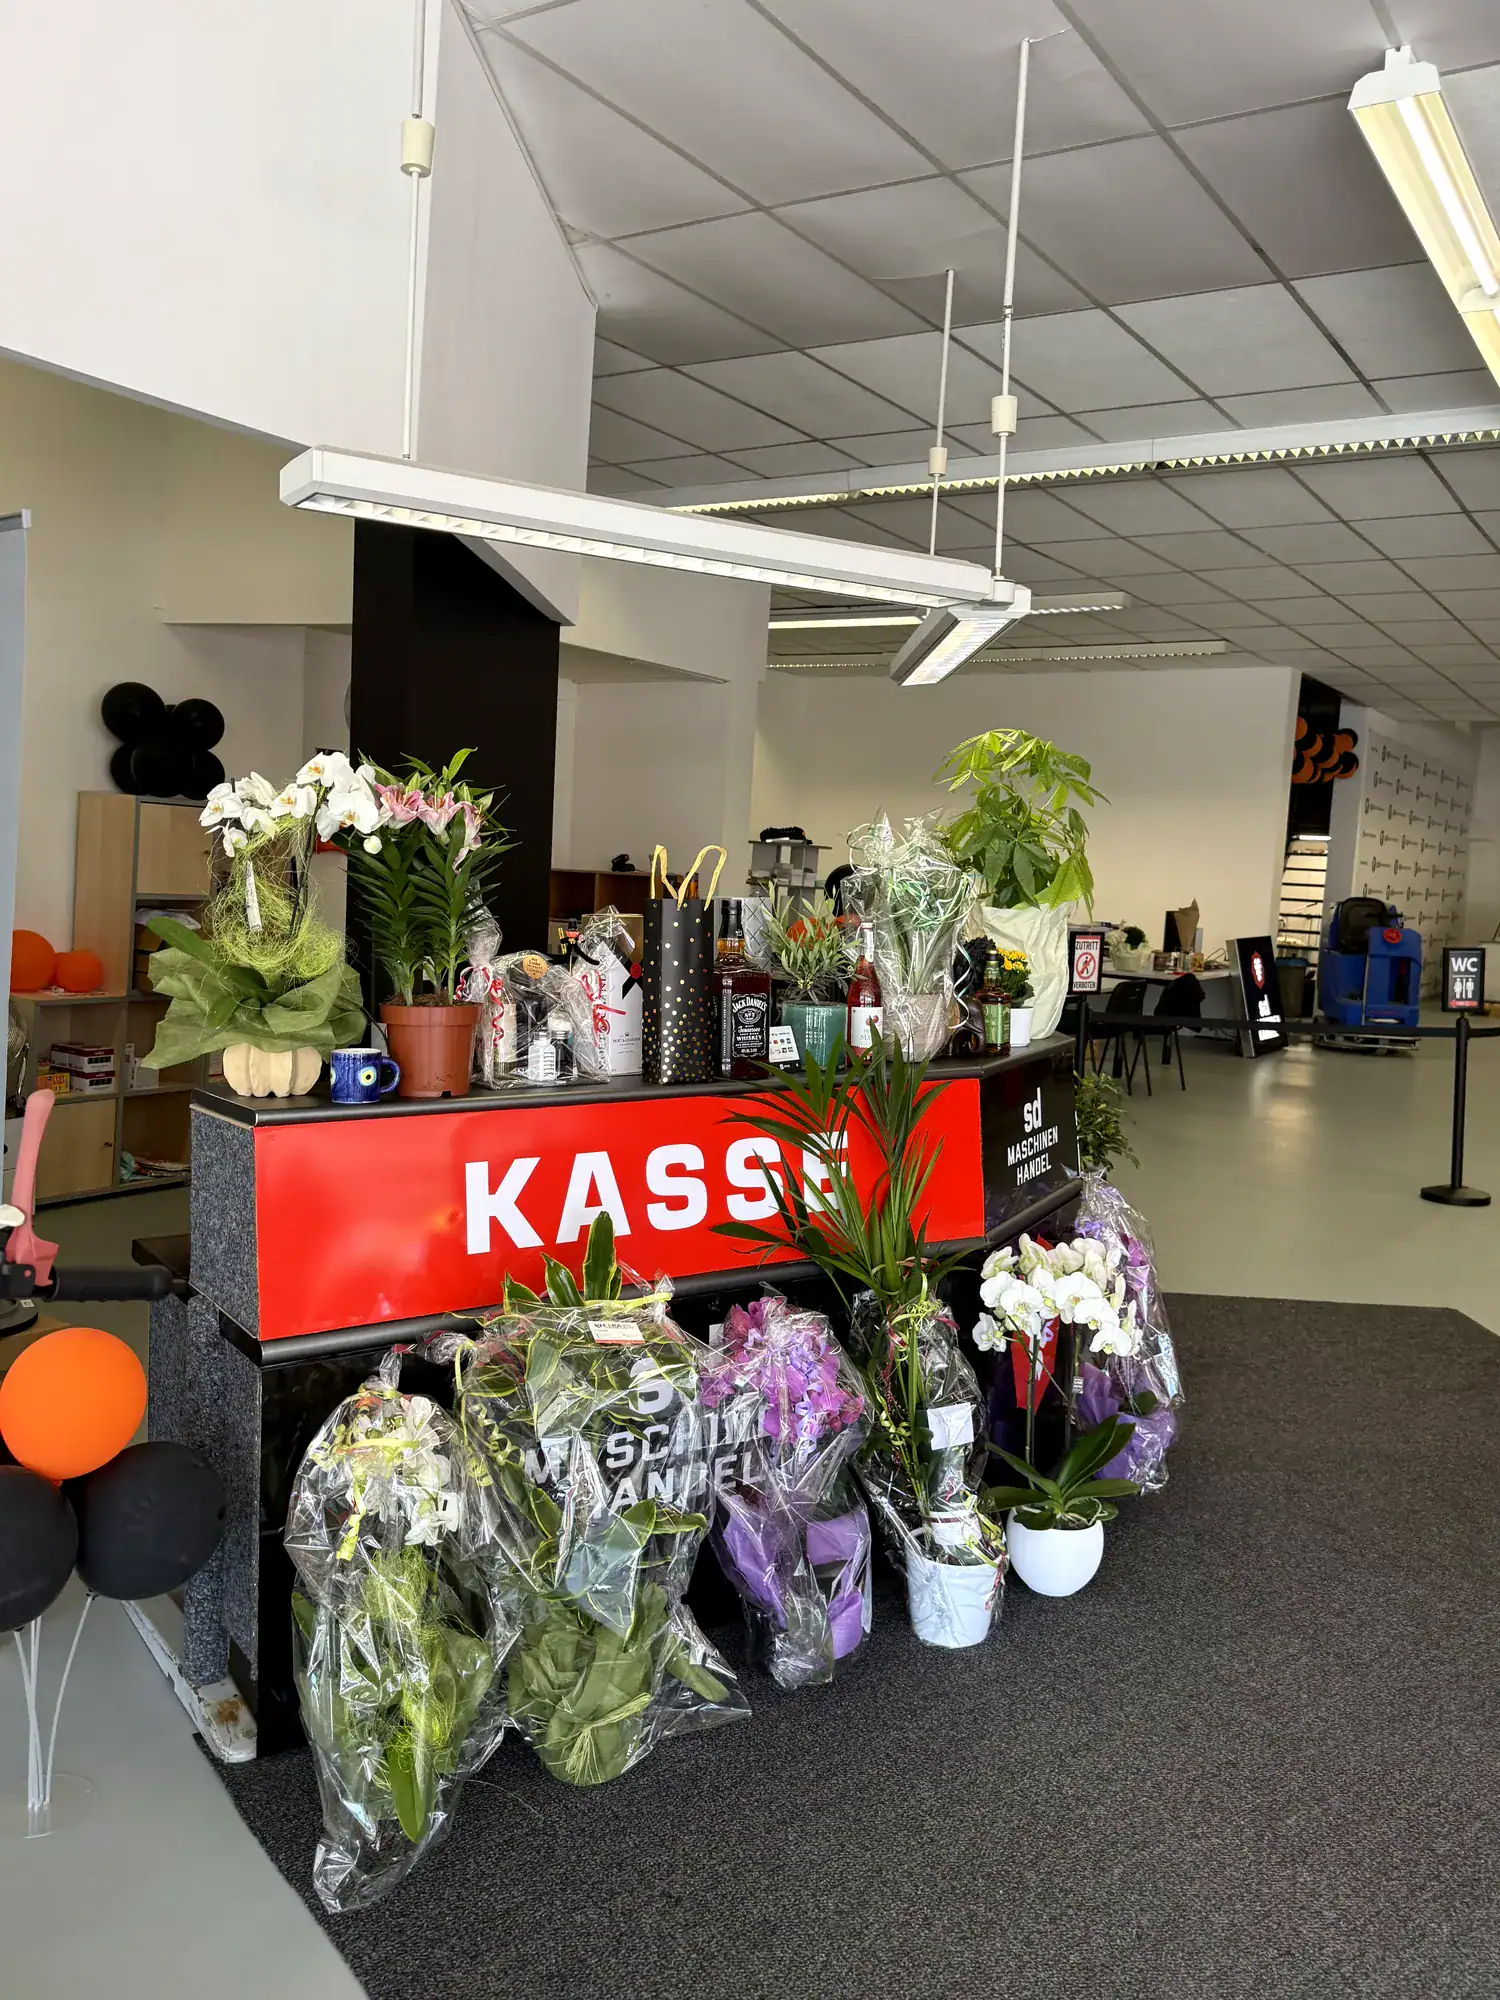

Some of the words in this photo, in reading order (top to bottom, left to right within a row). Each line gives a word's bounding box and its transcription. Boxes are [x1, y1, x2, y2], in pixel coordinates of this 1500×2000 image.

[1075, 940, 1099, 950] ZUTRITT
[1450, 957, 1478, 972] WC
[1073, 981, 1096, 989] VERBOTEN
[732, 1000, 746, 1012] JACK
[1023, 1087, 1042, 1133] sd
[1007, 1125, 1058, 1167] MASCHINEN
[1016, 1152, 1052, 1186] HANDEL
[465, 1131, 848, 1255] KASSE
